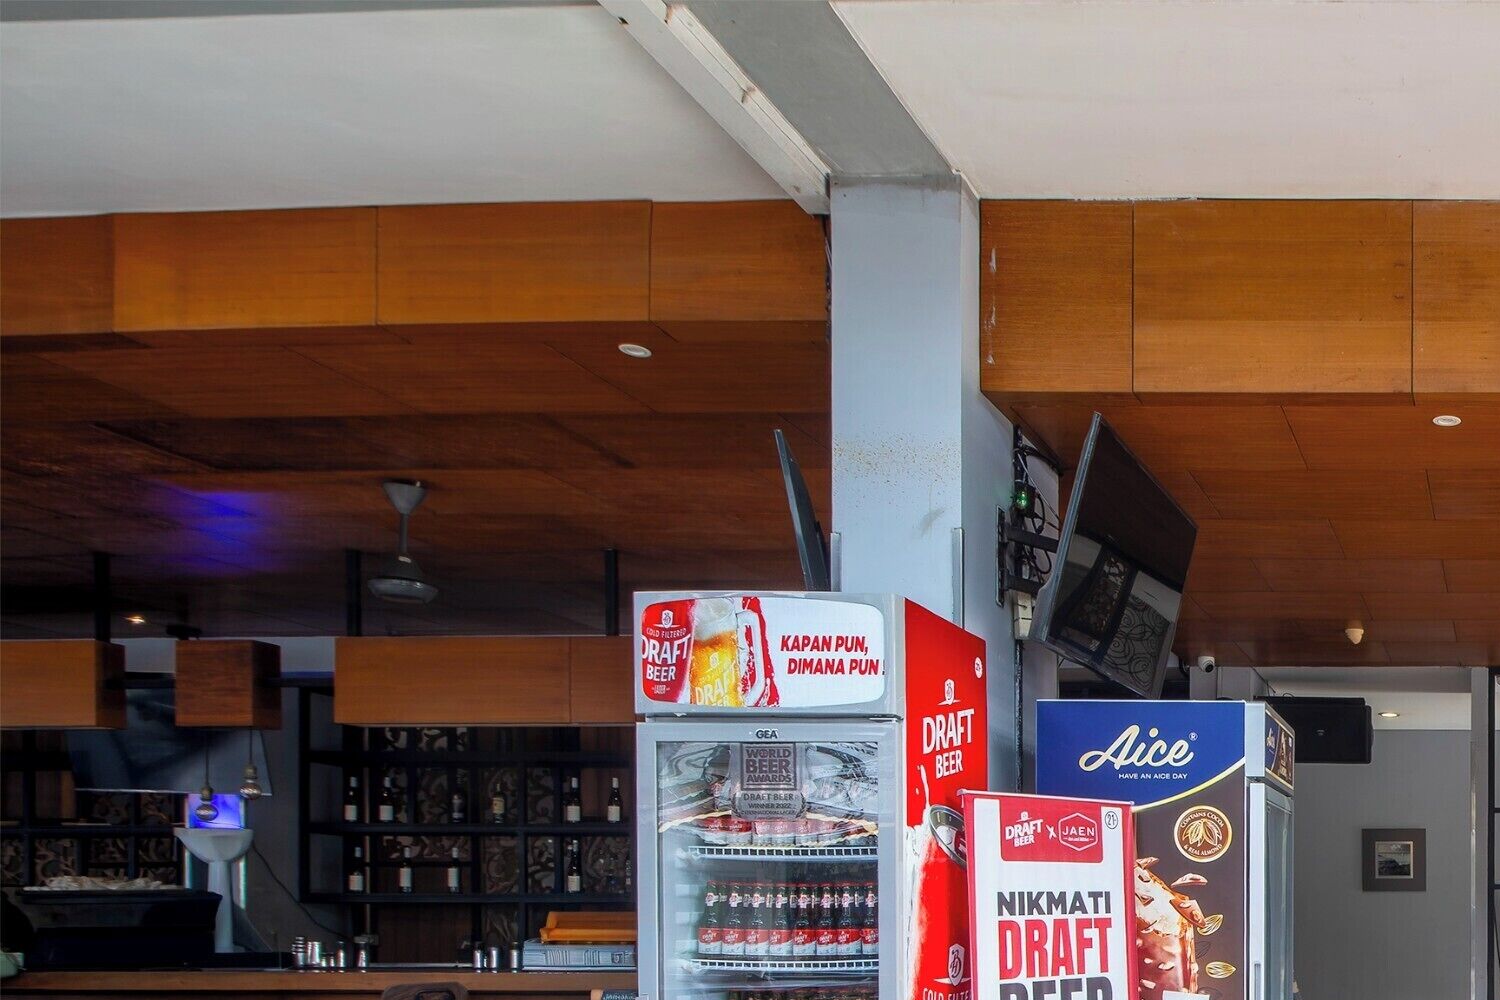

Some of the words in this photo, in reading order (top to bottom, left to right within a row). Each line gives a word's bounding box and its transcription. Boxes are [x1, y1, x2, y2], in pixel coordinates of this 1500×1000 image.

[646, 627, 660, 638] COLD
[661, 627, 687, 639] FILTERED
[641, 634, 691, 665] DRAFT
[780, 635, 833, 652] KAPAN
[835, 635, 869, 656] PUN,
[645, 664, 676, 682] BEER
[787, 657, 845, 675] DIMANA
[755, 729, 778, 739] GEA
[922, 708, 975, 755] DRAFT
[745, 748, 792, 759] WORLD
[1078, 724, 1195, 772] Aice
[745, 758, 791, 774] BEER
[935, 749, 963, 779] BEER
[745, 774, 793, 783] AWARDS
[743, 793, 772, 801] DRAFT
[773, 793, 794, 801] BEER
[1180, 812, 1206, 829] CONTAINS
[1005, 819, 1044, 841] DRAFT
[1062, 826, 1095, 837] JAEN
[1013, 834, 1035, 848] BEER
[1200, 843, 1223, 856] ALMOND
[997, 890, 1112, 916] NIKMATI
[997, 917, 1112, 981] DRAFT
